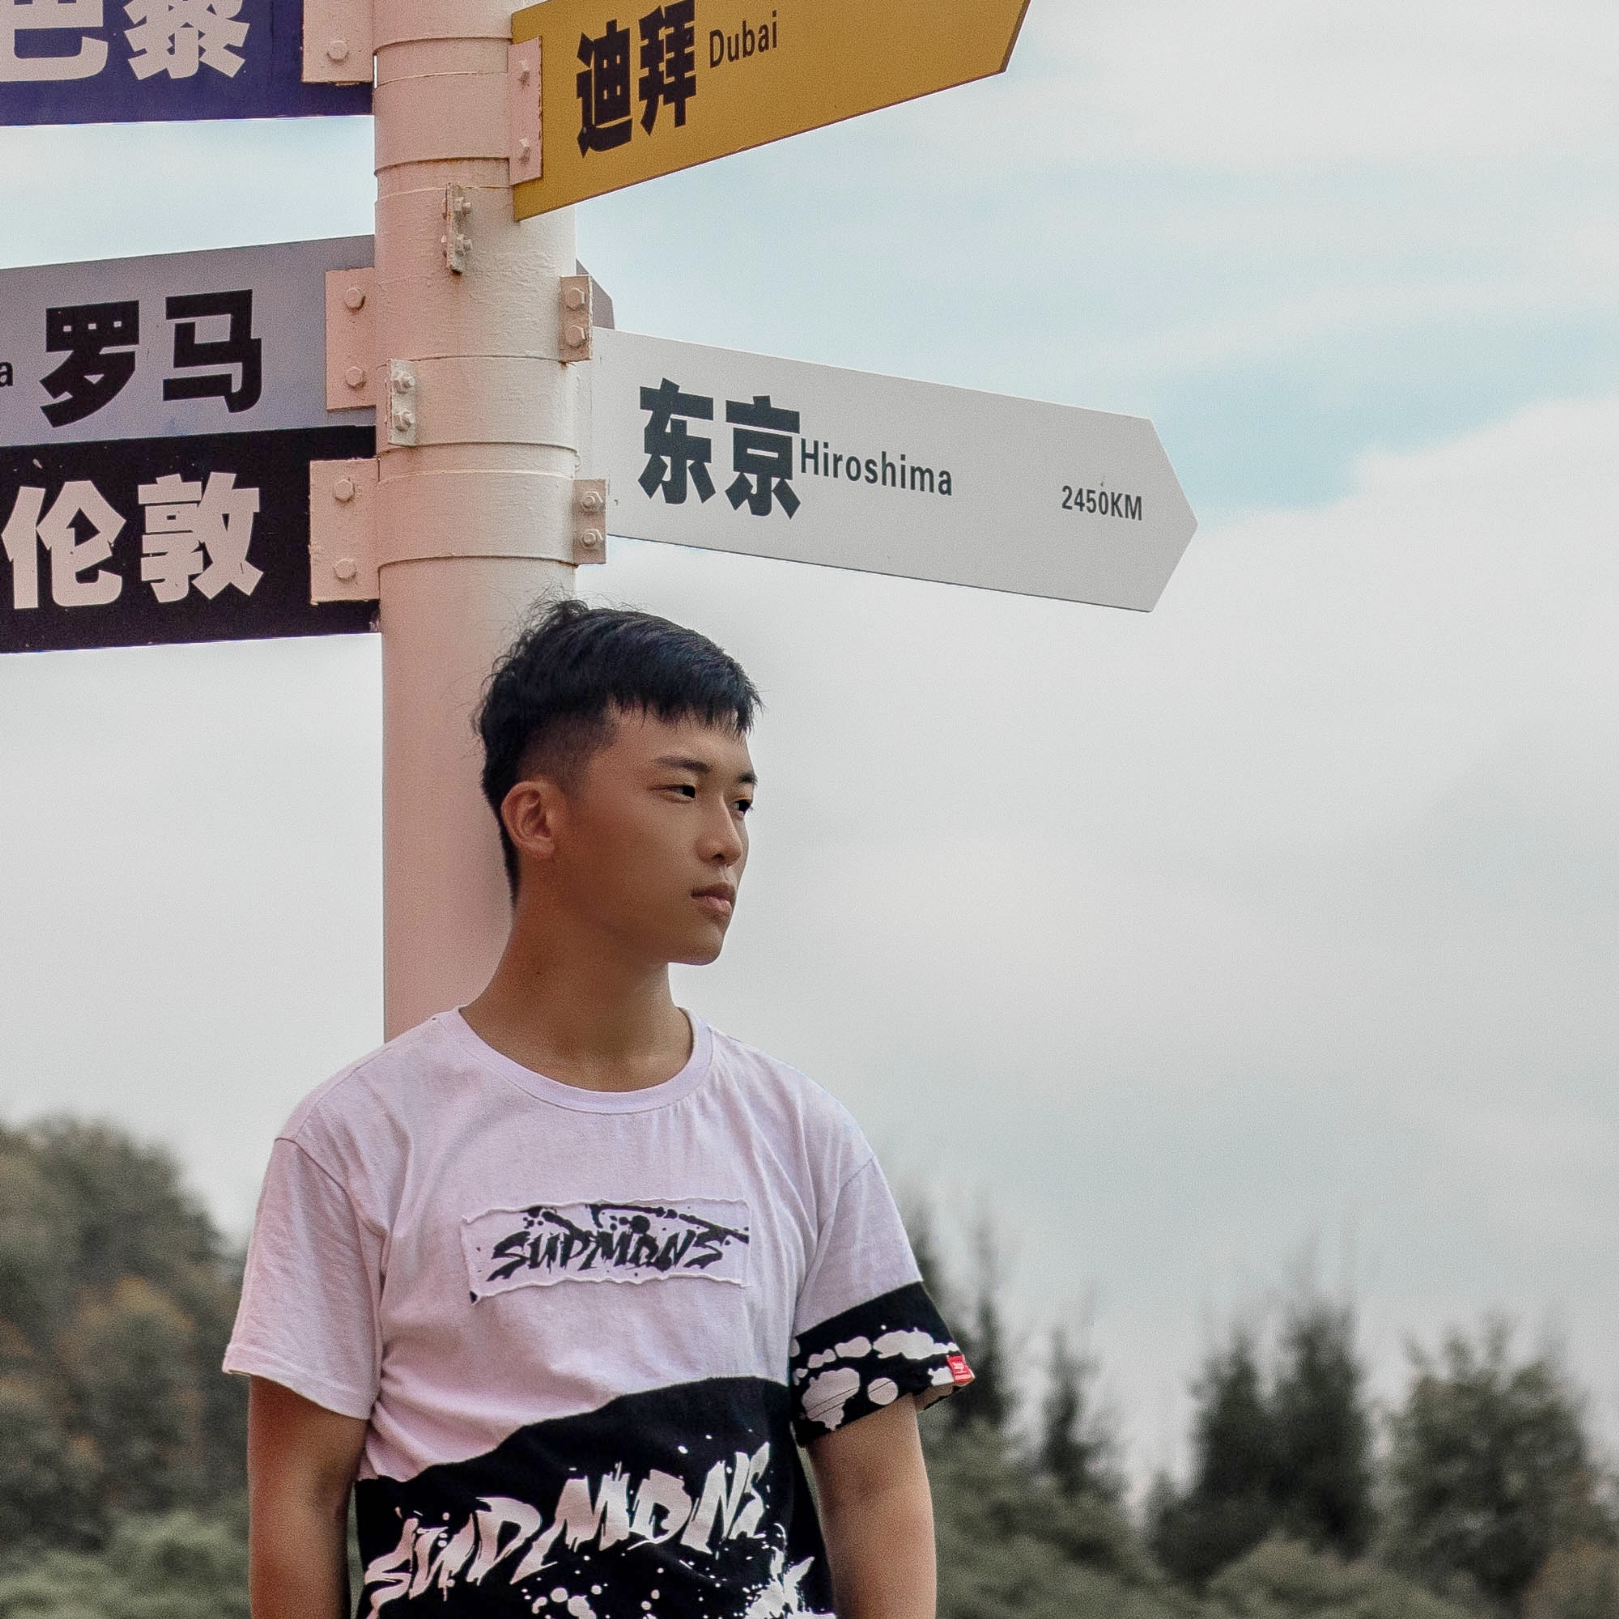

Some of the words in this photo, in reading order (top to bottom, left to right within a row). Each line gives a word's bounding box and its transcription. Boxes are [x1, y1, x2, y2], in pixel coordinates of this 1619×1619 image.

[708, 10, 779, 68] Dubai
[39, 288, 266, 429] 罗马
[638, 377, 801, 519] 东京
[800, 439, 954, 497] Hiroshima
[1061, 485, 1144, 522] 2450KM
[2, 470, 264, 610] 伦敦
